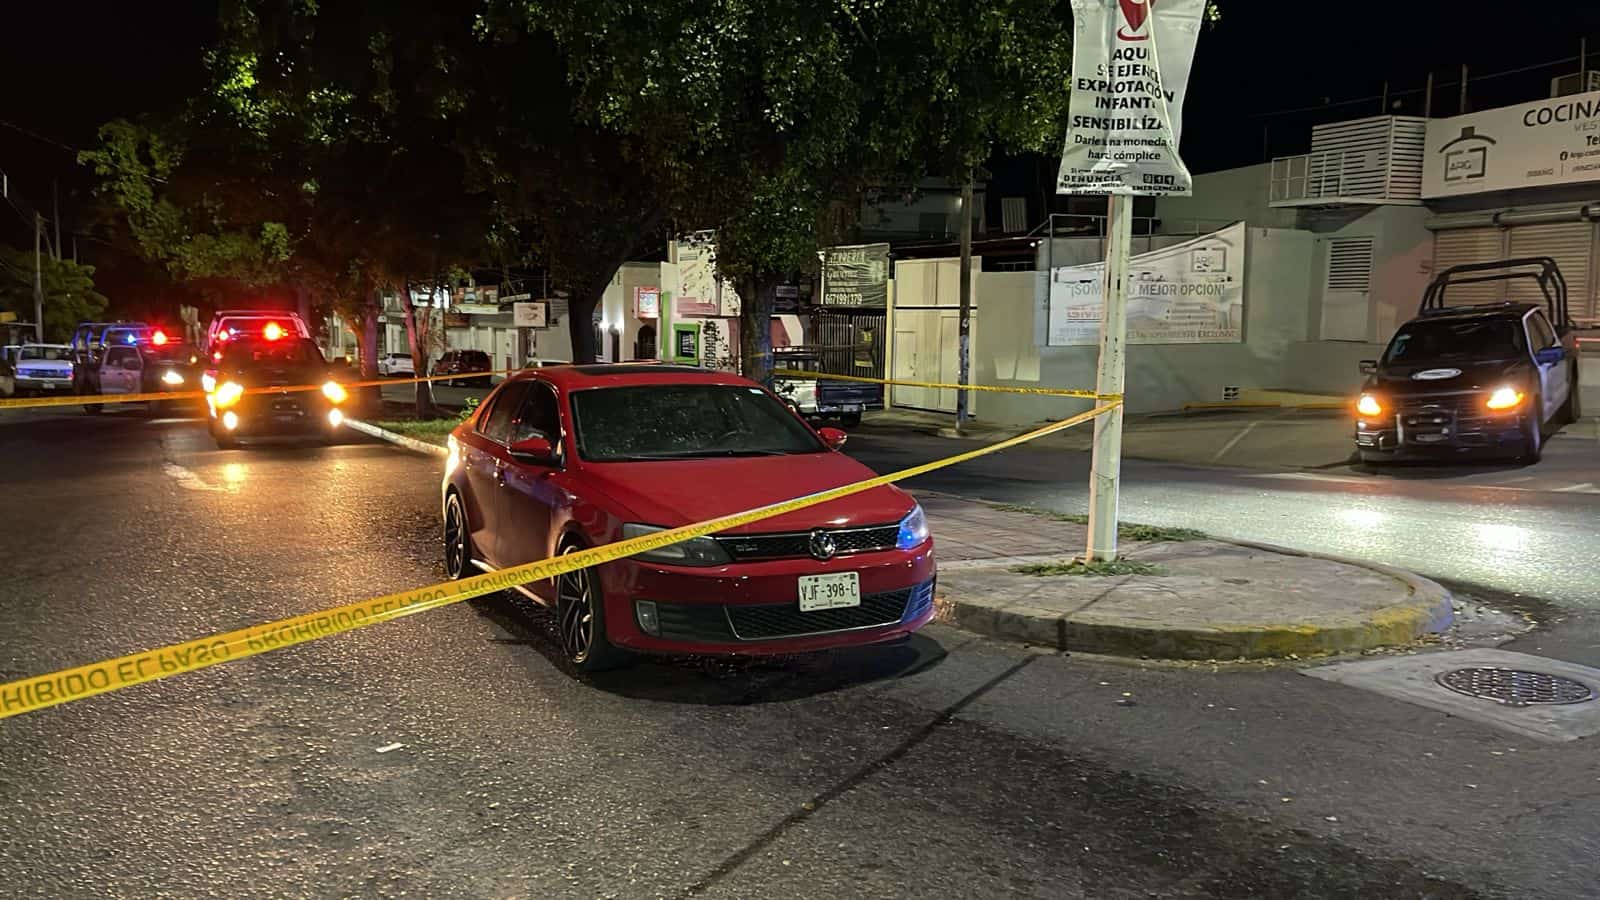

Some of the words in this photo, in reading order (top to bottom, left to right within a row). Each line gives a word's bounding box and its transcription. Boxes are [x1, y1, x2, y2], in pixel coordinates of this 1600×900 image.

[1113, 150, 1161, 162] cómplice
[1139, 283, 1177, 296] MEJOR
[801, 582, 857, 601] VJF-398-C
